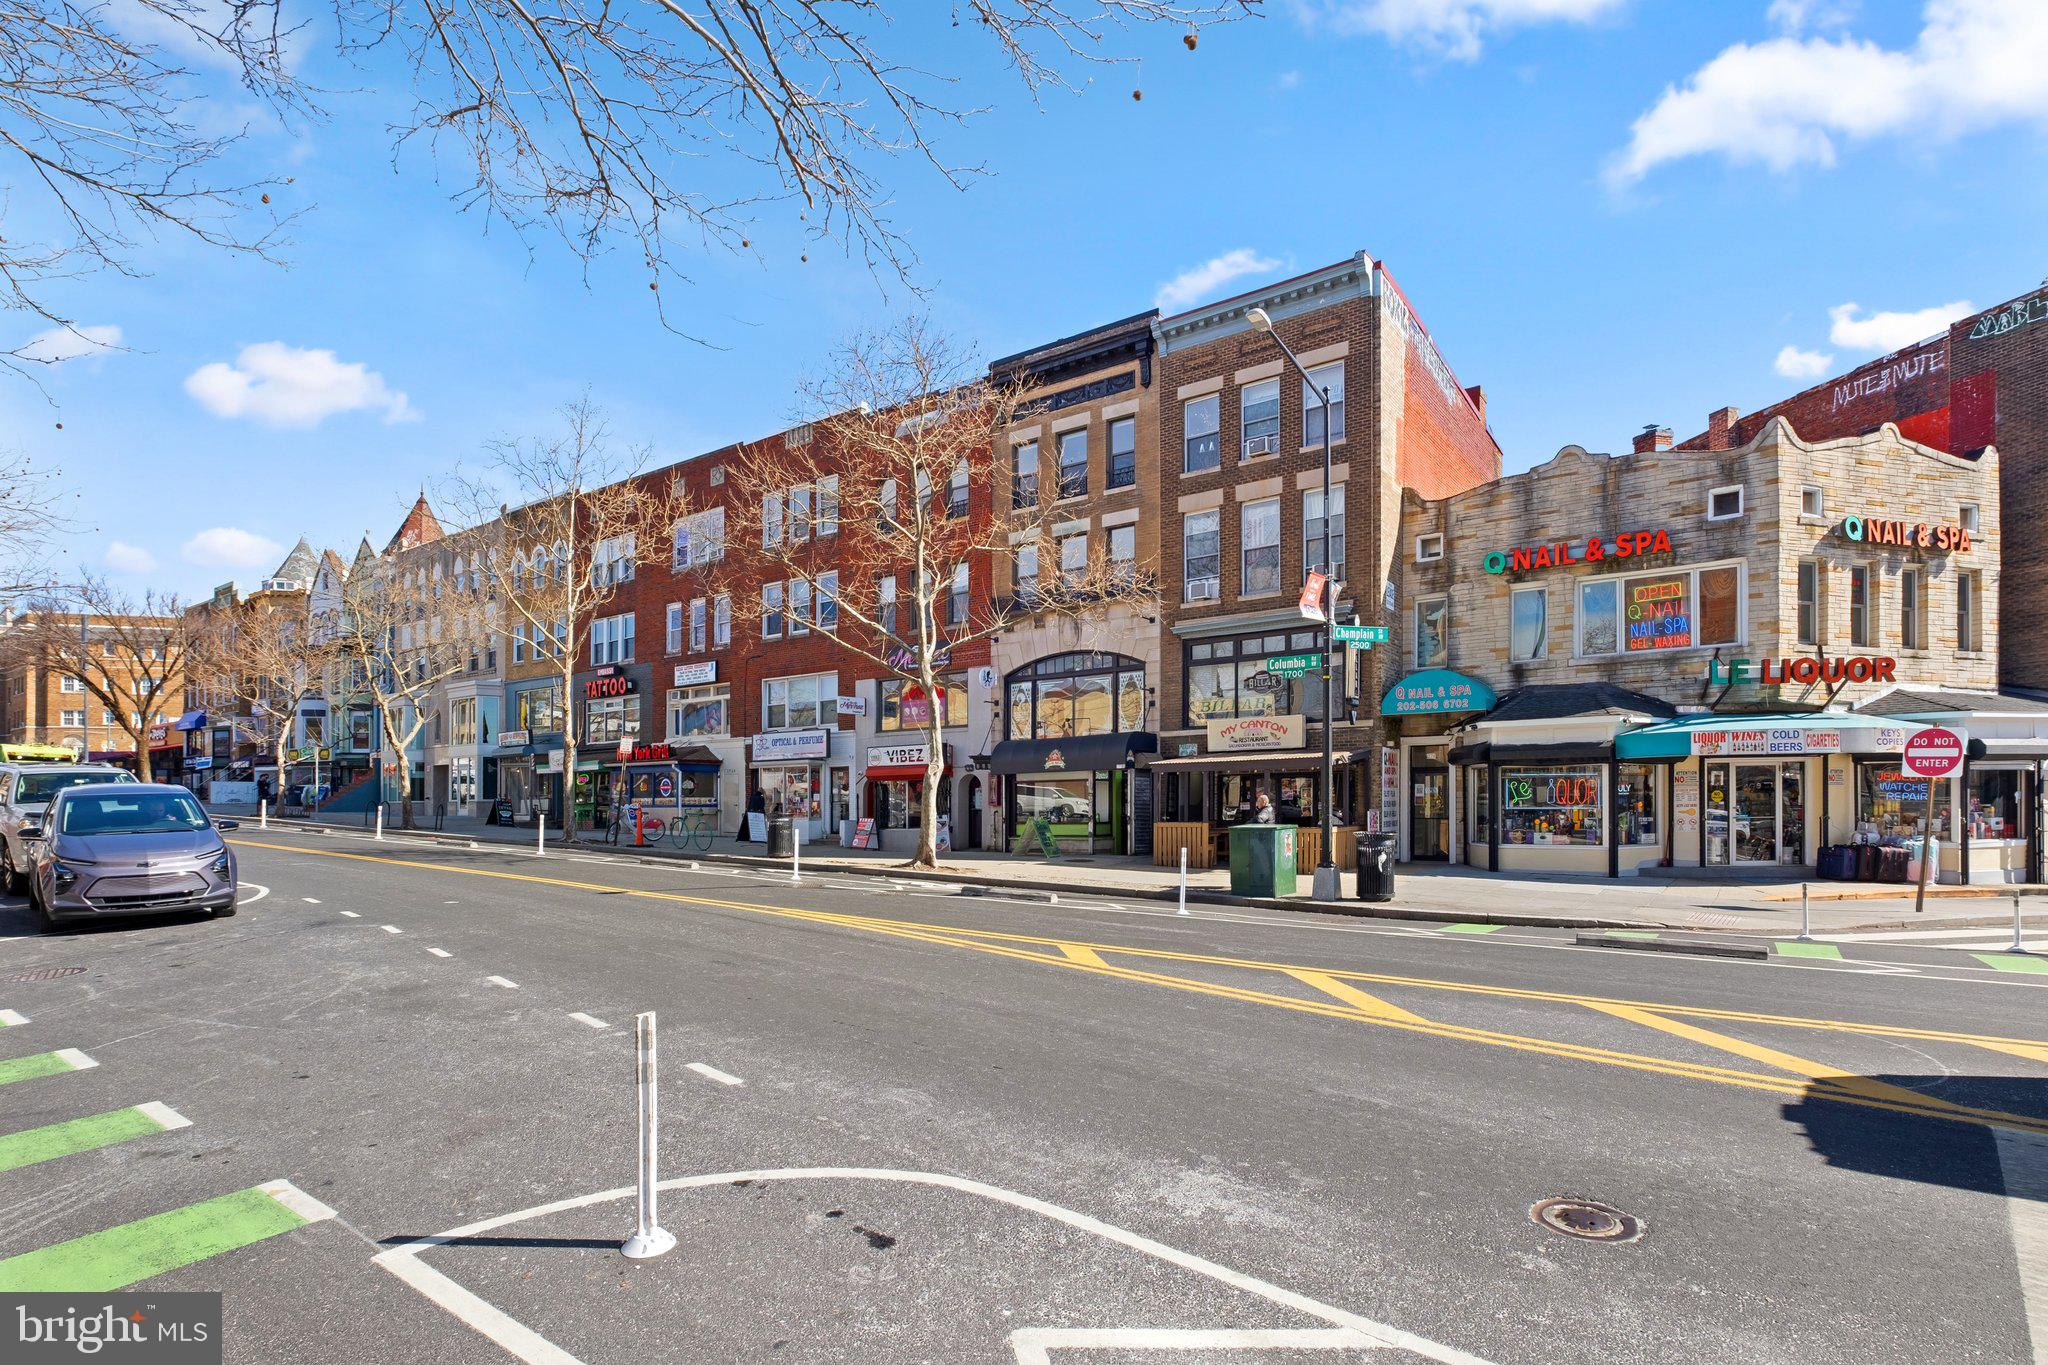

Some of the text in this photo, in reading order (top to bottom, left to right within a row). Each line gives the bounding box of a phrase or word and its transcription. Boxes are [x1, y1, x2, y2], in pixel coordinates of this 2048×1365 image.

[1843, 515, 1971, 551] Q NAIL & SPA
[1483, 529, 1672, 575] Q NAIL & SPA
[1635, 584, 1681, 601] OPEN
[1335, 627, 1375, 641] Champlain
[1350, 641, 1370, 649] 2500
[1269, 655, 1306, 670] Columbia
[1284, 670, 1303, 678] 1700
[1709, 656, 1896, 685] LE LIQUOR
[585, 677, 627, 699] TATTOO
[1395, 685, 1472, 700] Q NAIL & SPA
[1220, 719, 1288, 738] MY CANTON
[1880, 728, 1901, 738] KEYS
[1693, 731, 1726, 744] LIQUOR
[1731, 731, 1765, 742] WINES
[1772, 730, 1800, 740] COLD
[772, 737, 792, 747] OPTICAL
[798, 736, 824, 745] PERFUME
[1769, 742, 1803, 752] BEERS
[1876, 737, 1904, 746] COPIES
[1913, 737, 1956, 746] DO NOT
[633, 745, 650, 760] York
[887, 748, 924, 763] VIBEZ
[1915, 759, 1949, 767] ENTER
[1674, 776, 1686, 784] NO
[1885, 791, 1929, 801] REPAIR
